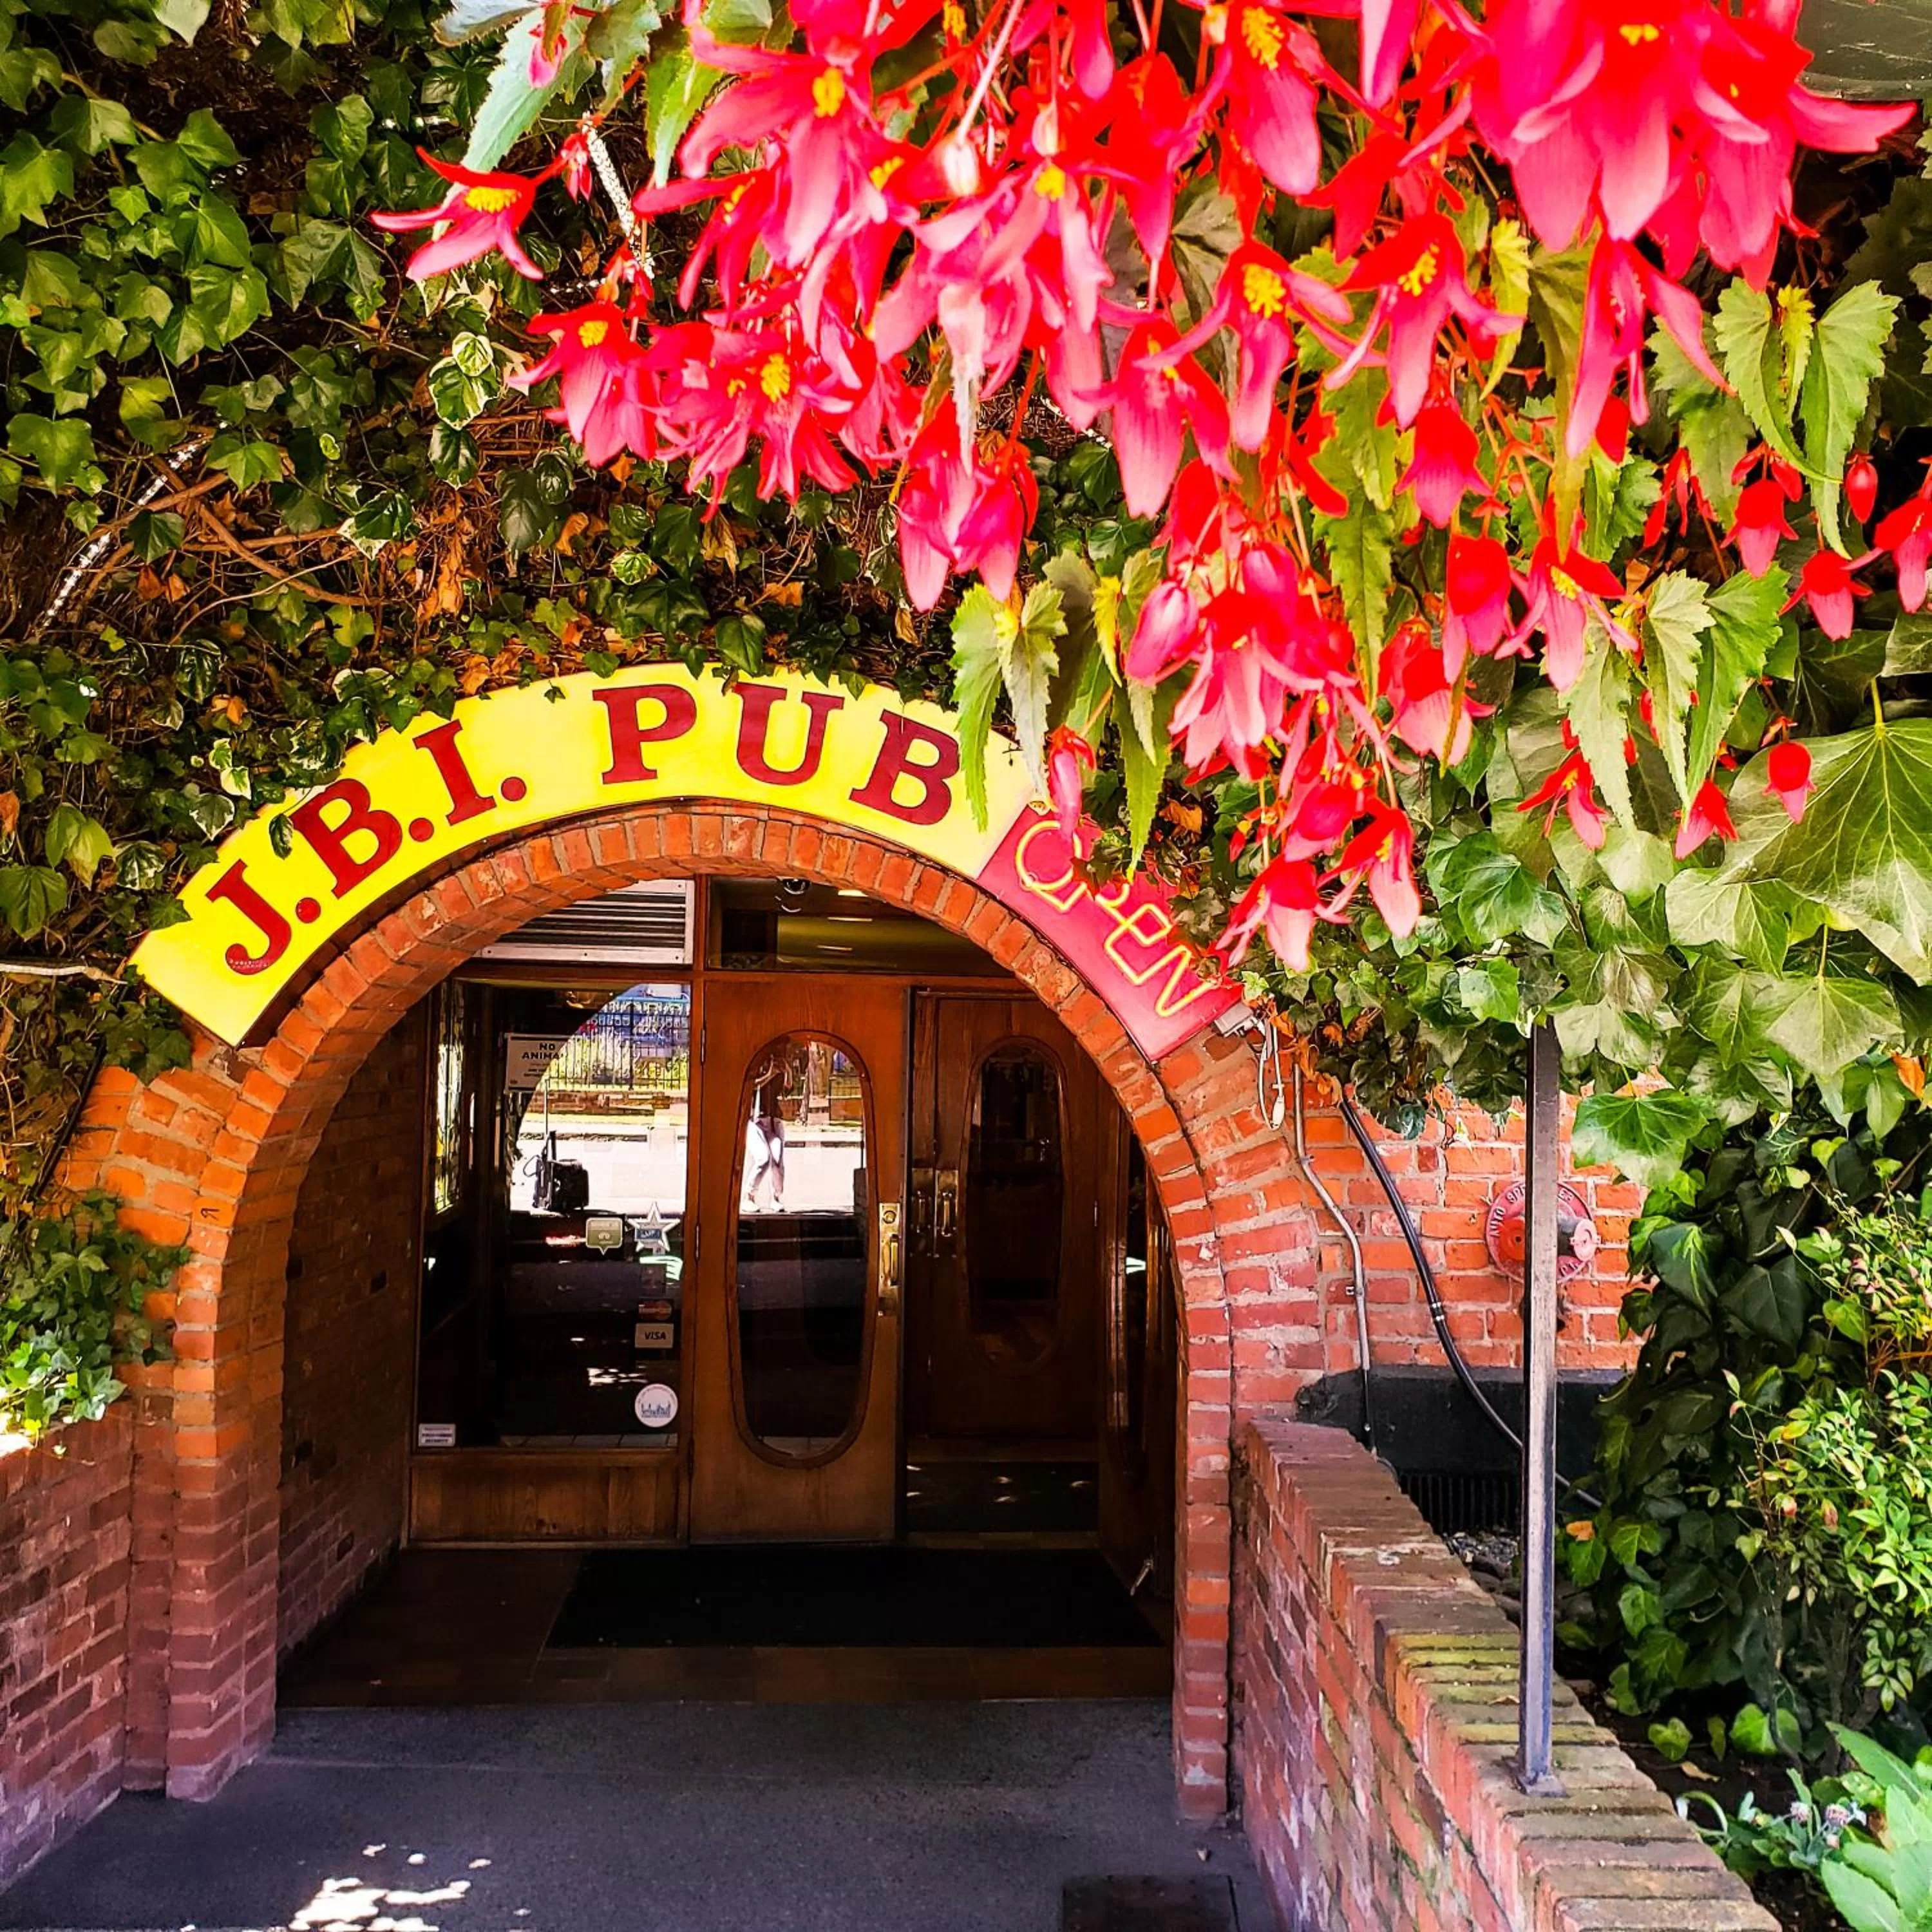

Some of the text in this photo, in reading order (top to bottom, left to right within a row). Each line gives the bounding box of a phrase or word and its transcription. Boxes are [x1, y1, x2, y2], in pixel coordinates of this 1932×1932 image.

[205, 681, 960, 976] J.B.I. PUB
[1489, 1206, 1506, 1238] AUTO
[644, 1331, 667, 1340] VISA
